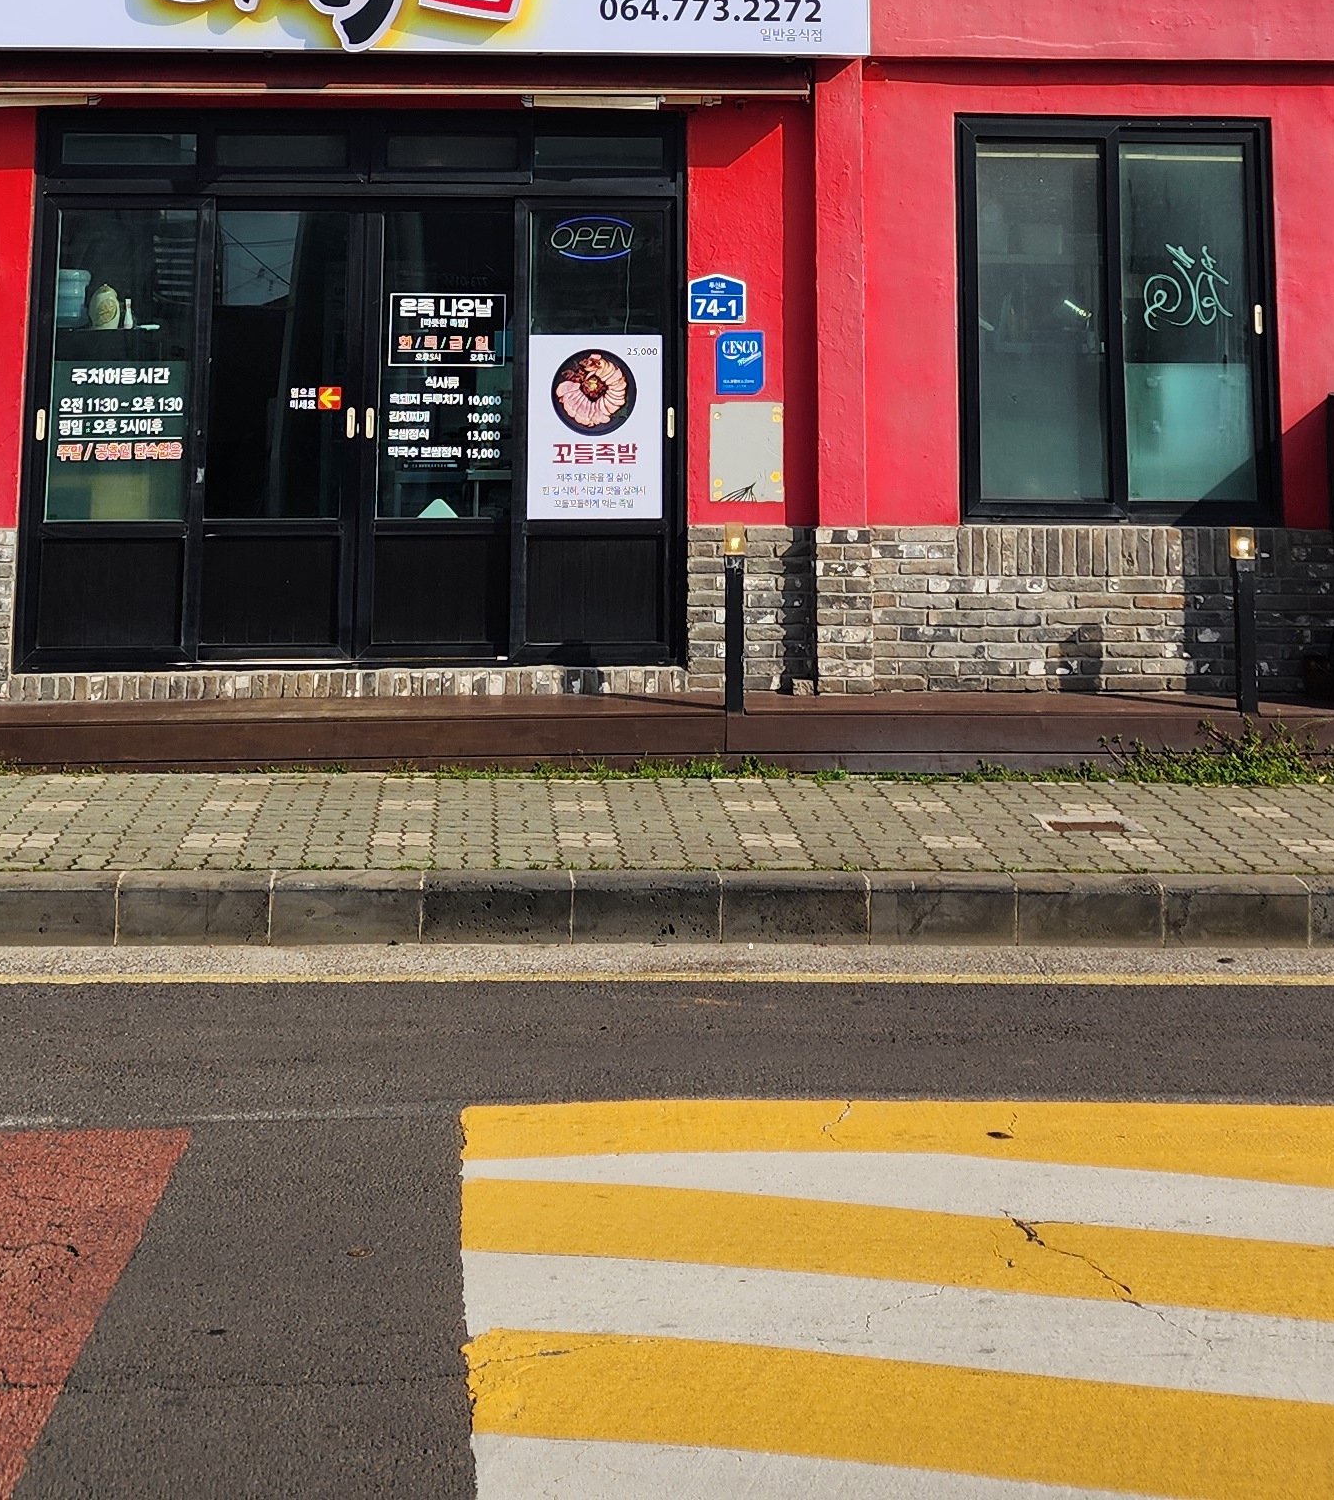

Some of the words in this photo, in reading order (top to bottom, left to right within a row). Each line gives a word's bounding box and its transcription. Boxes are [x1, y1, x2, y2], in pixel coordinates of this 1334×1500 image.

[760, 28, 822, 43] 일반음식점
[551, 227, 635, 249] OPEN
[694, 298, 737, 317] 74-1
[449, 335, 463, 350] 금
[721, 340, 759, 354] CESCO
[627, 348, 658, 356] 25,000
[71, 367, 170, 385] 주차허용시간
[425, 376, 460, 389] 식사류
[59, 397, 83, 413] 오전
[86, 397, 119, 412] 11:30
[131, 397, 155, 412] 오후
[157, 397, 183, 411] 1:30
[389, 393, 421, 405] 흑돼지
[422, 393, 464, 405] 두루치기
[467, 395, 502, 407] 10,000
[388, 411, 430, 423] 김치찌개
[467, 413, 501, 424] 10,000
[58, 419, 83, 435] 평일
[92, 418, 117, 435] 오후
[387, 428, 430, 441] 보쌈정식
[466, 431, 501, 442] 13,000
[387, 446, 419, 458] 막국수
[420, 446, 462, 458] 보쌈정식
[466, 448, 500, 459] 15,000
[552, 443, 638, 465] 꼬들족발
